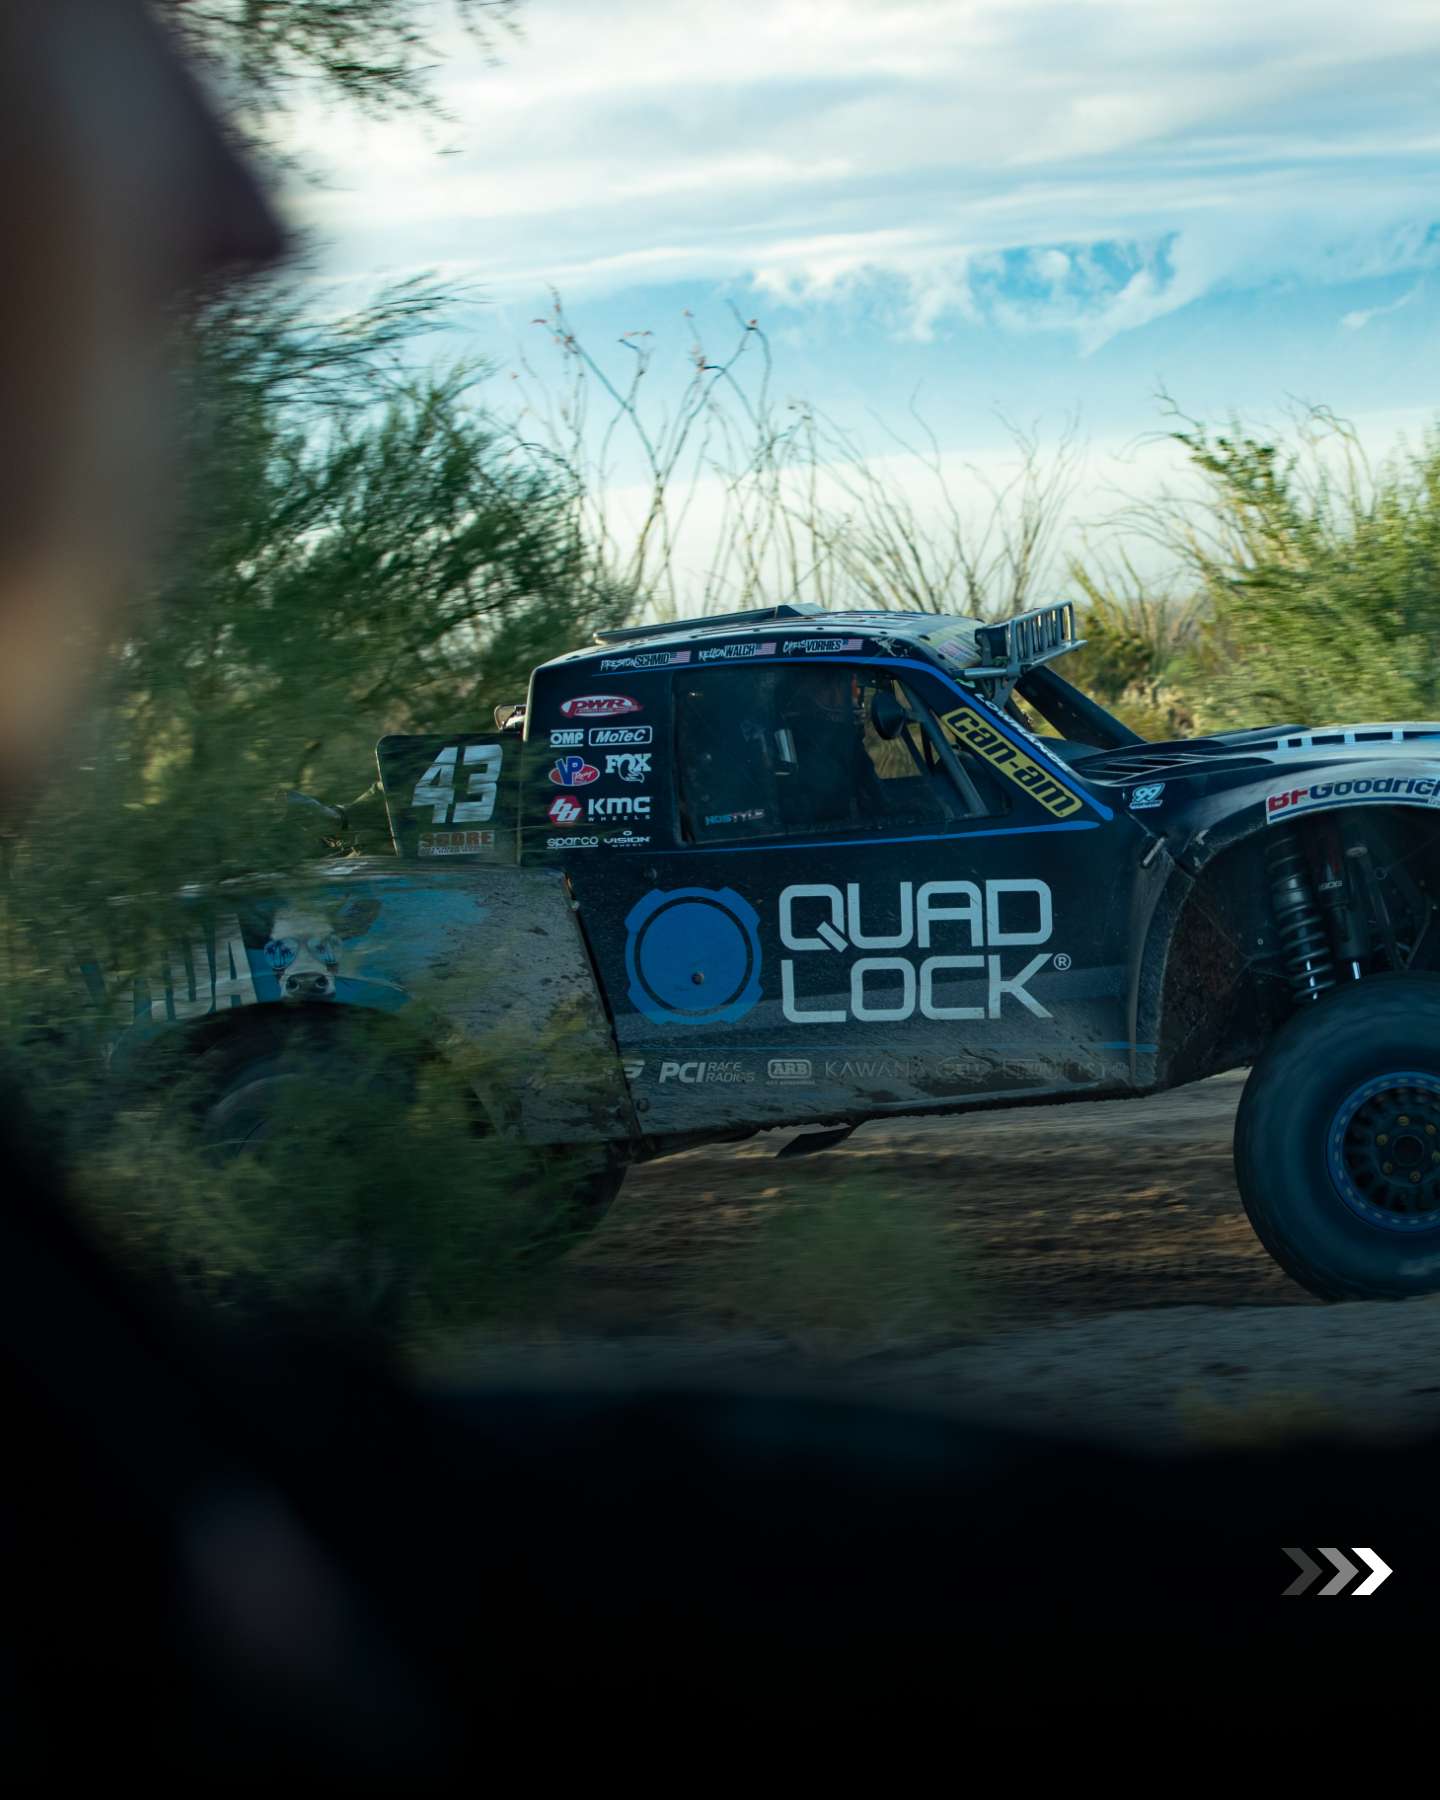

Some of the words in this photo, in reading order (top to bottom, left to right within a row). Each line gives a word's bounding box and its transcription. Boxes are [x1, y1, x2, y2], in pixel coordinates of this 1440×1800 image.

[805, 638, 843, 653] VORHIES
[635, 652, 671, 668] SCHMID
[550, 732, 584, 745] OMP
[595, 729, 647, 744] MoTeC
[554, 755, 585, 786] VP
[604, 752, 653, 784] FOX
[412, 743, 503, 824] 43
[546, 836, 599, 849] sparco
[603, 836, 651, 844] VISION
[778, 878, 1053, 953] QUAD
[658, 1061, 706, 1084] PCI
[706, 1061, 743, 1073] RACE
[772, 1062, 808, 1075] ARB
